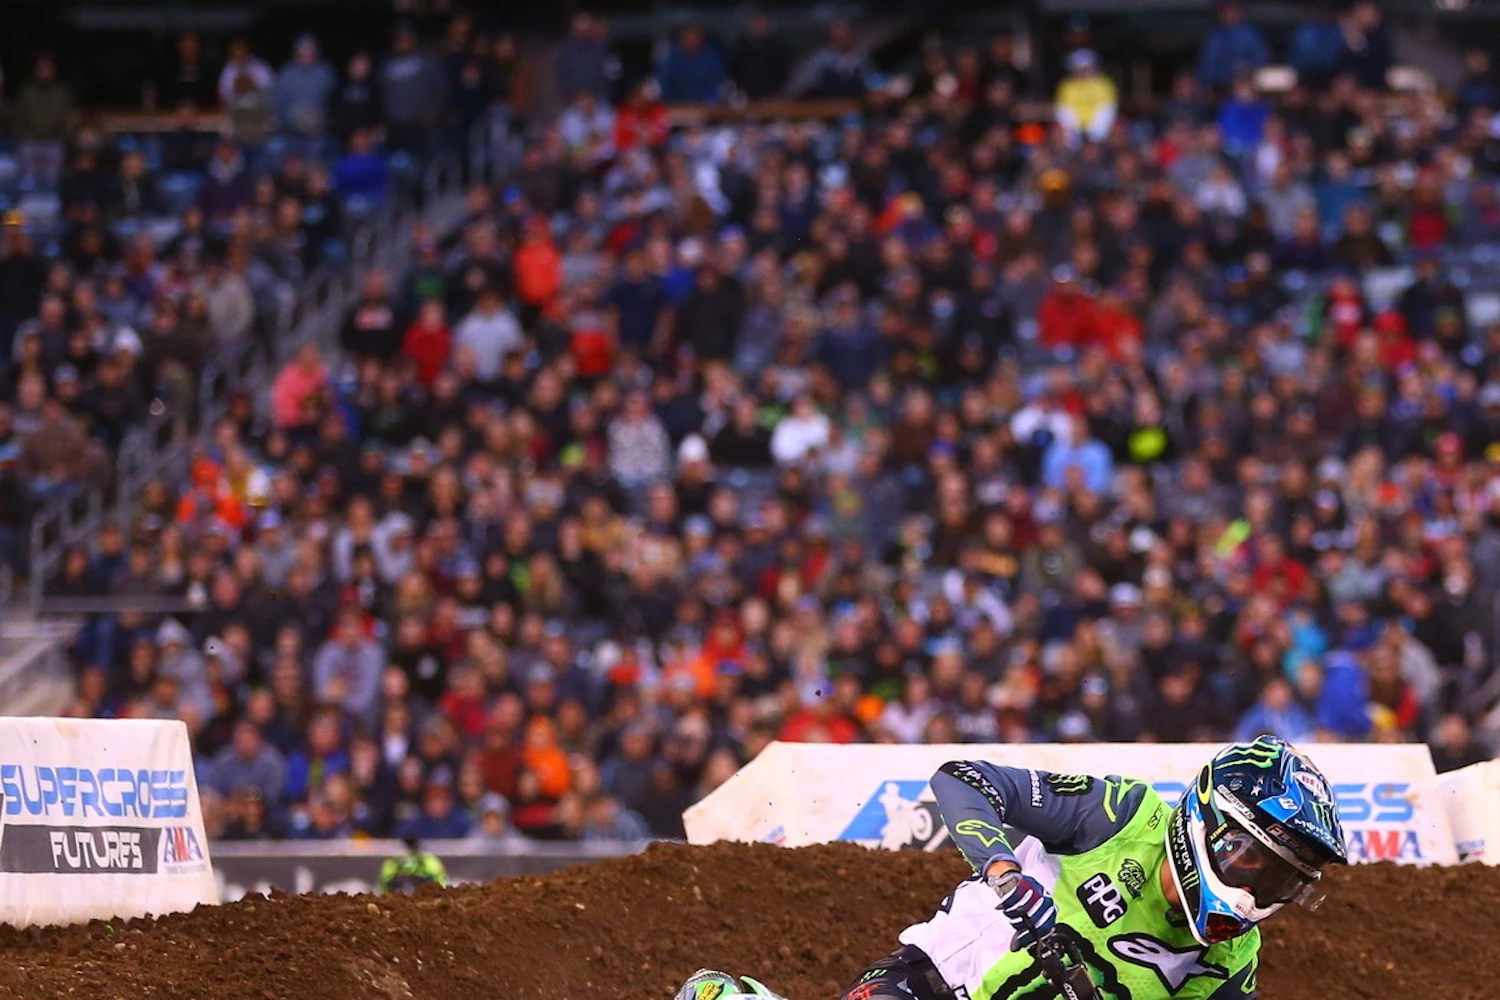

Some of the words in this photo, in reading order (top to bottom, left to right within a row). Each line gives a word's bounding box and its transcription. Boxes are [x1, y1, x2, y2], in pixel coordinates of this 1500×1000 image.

[1, 764, 188, 818] SUPERCROSS
[50, 831, 143, 868] FUTURES
[164, 826, 204, 862] AMA
[1348, 829, 1425, 859] AMA
[1083, 875, 1124, 924] PPG
